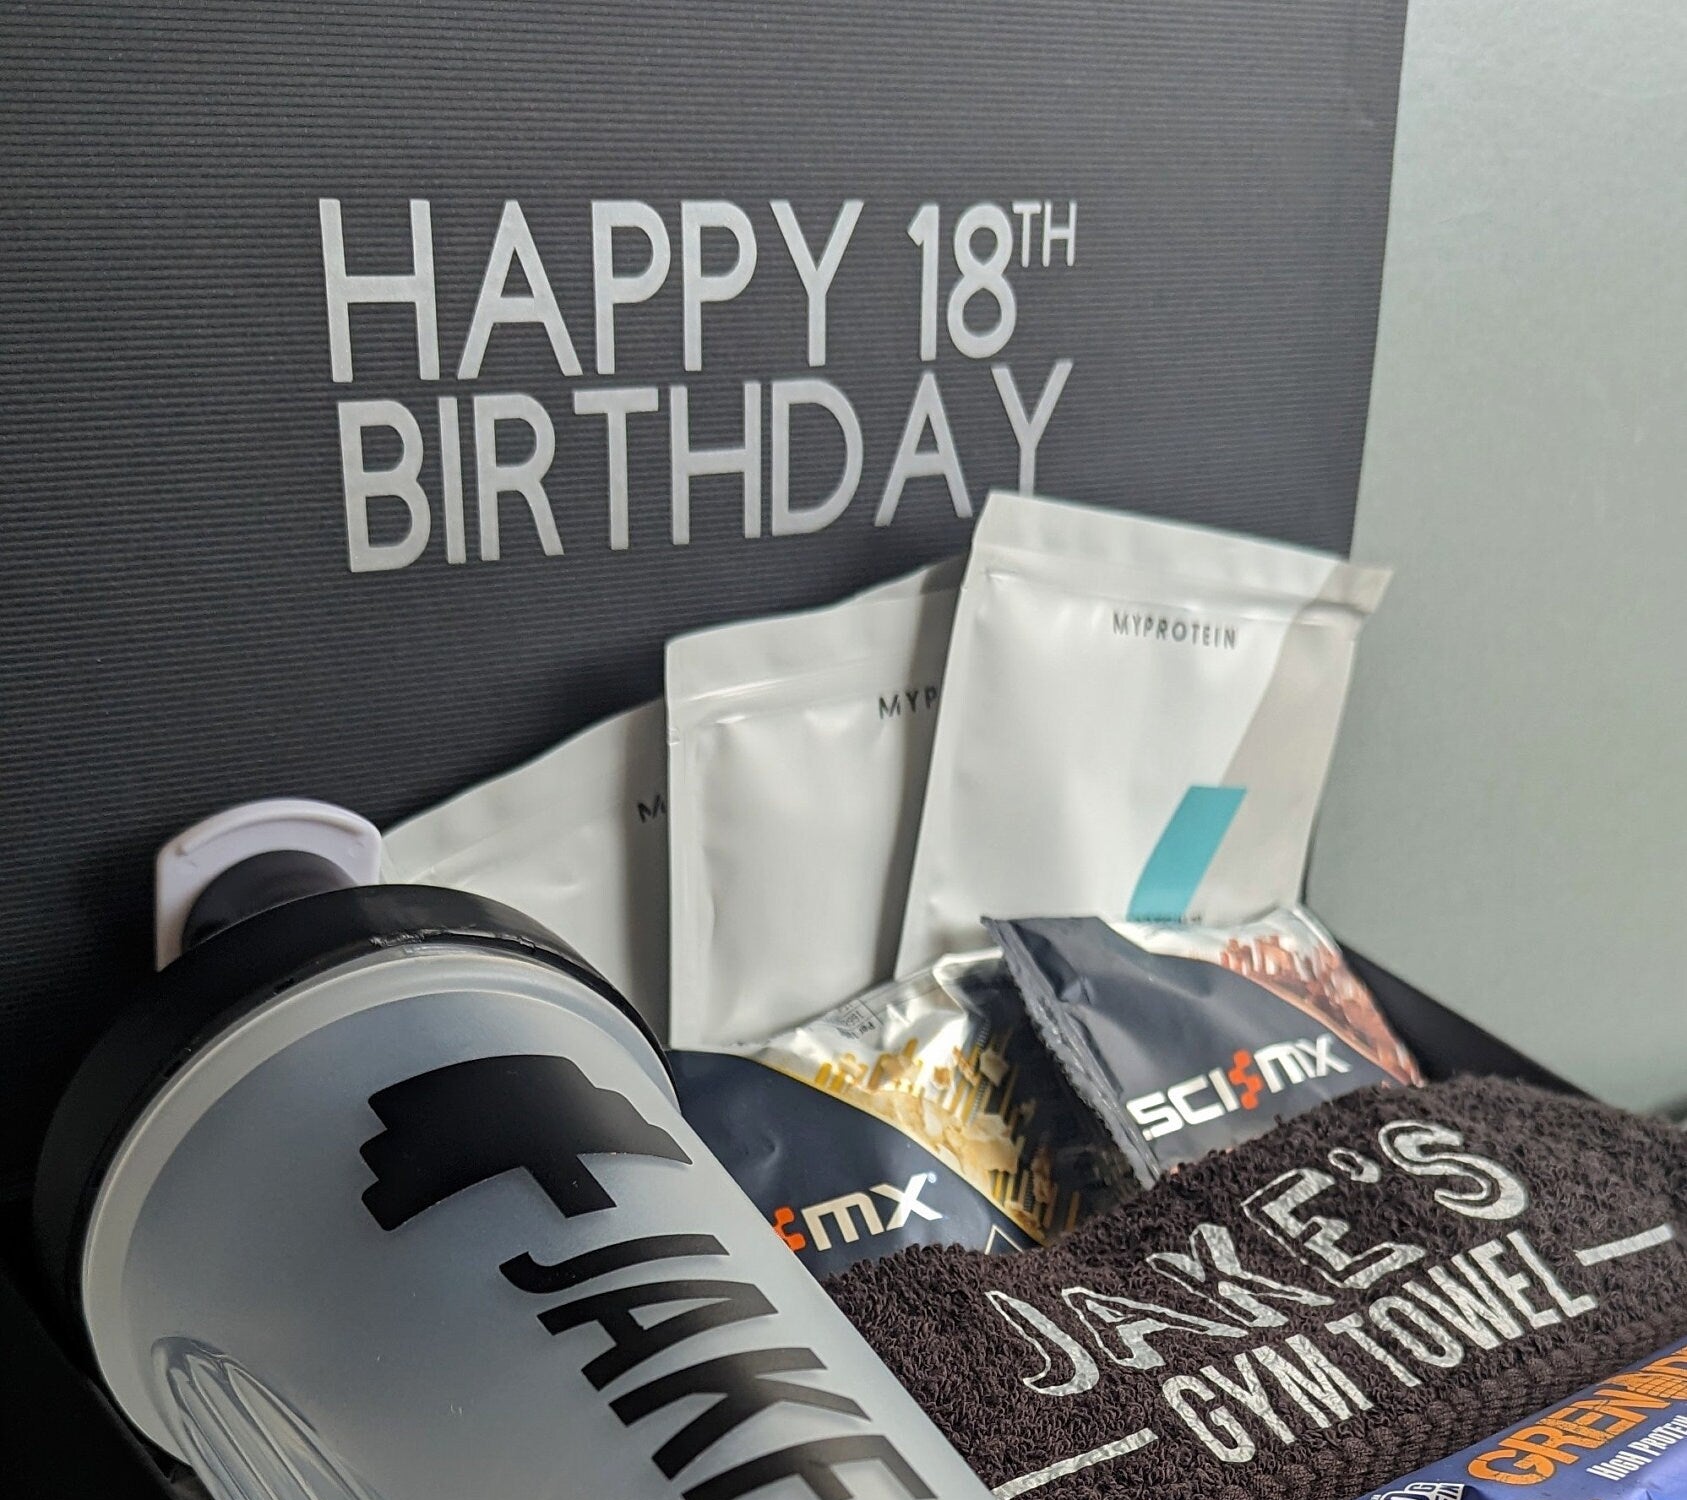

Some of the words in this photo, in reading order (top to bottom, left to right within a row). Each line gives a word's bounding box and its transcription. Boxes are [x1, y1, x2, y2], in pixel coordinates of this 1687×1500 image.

[318, 197, 865, 383] HAPPY
[337, 358, 1074, 573] BIRTHDAY
[1112, 610, 1237, 650] MYPROTEIN
[984, 1118, 1529, 1396] JAKE'S
[1162, 1335, 1373, 1463] GYM
[1324, 1230, 1598, 1387] TOWEL
[1586, 1449, 1652, 1482] HIGH
